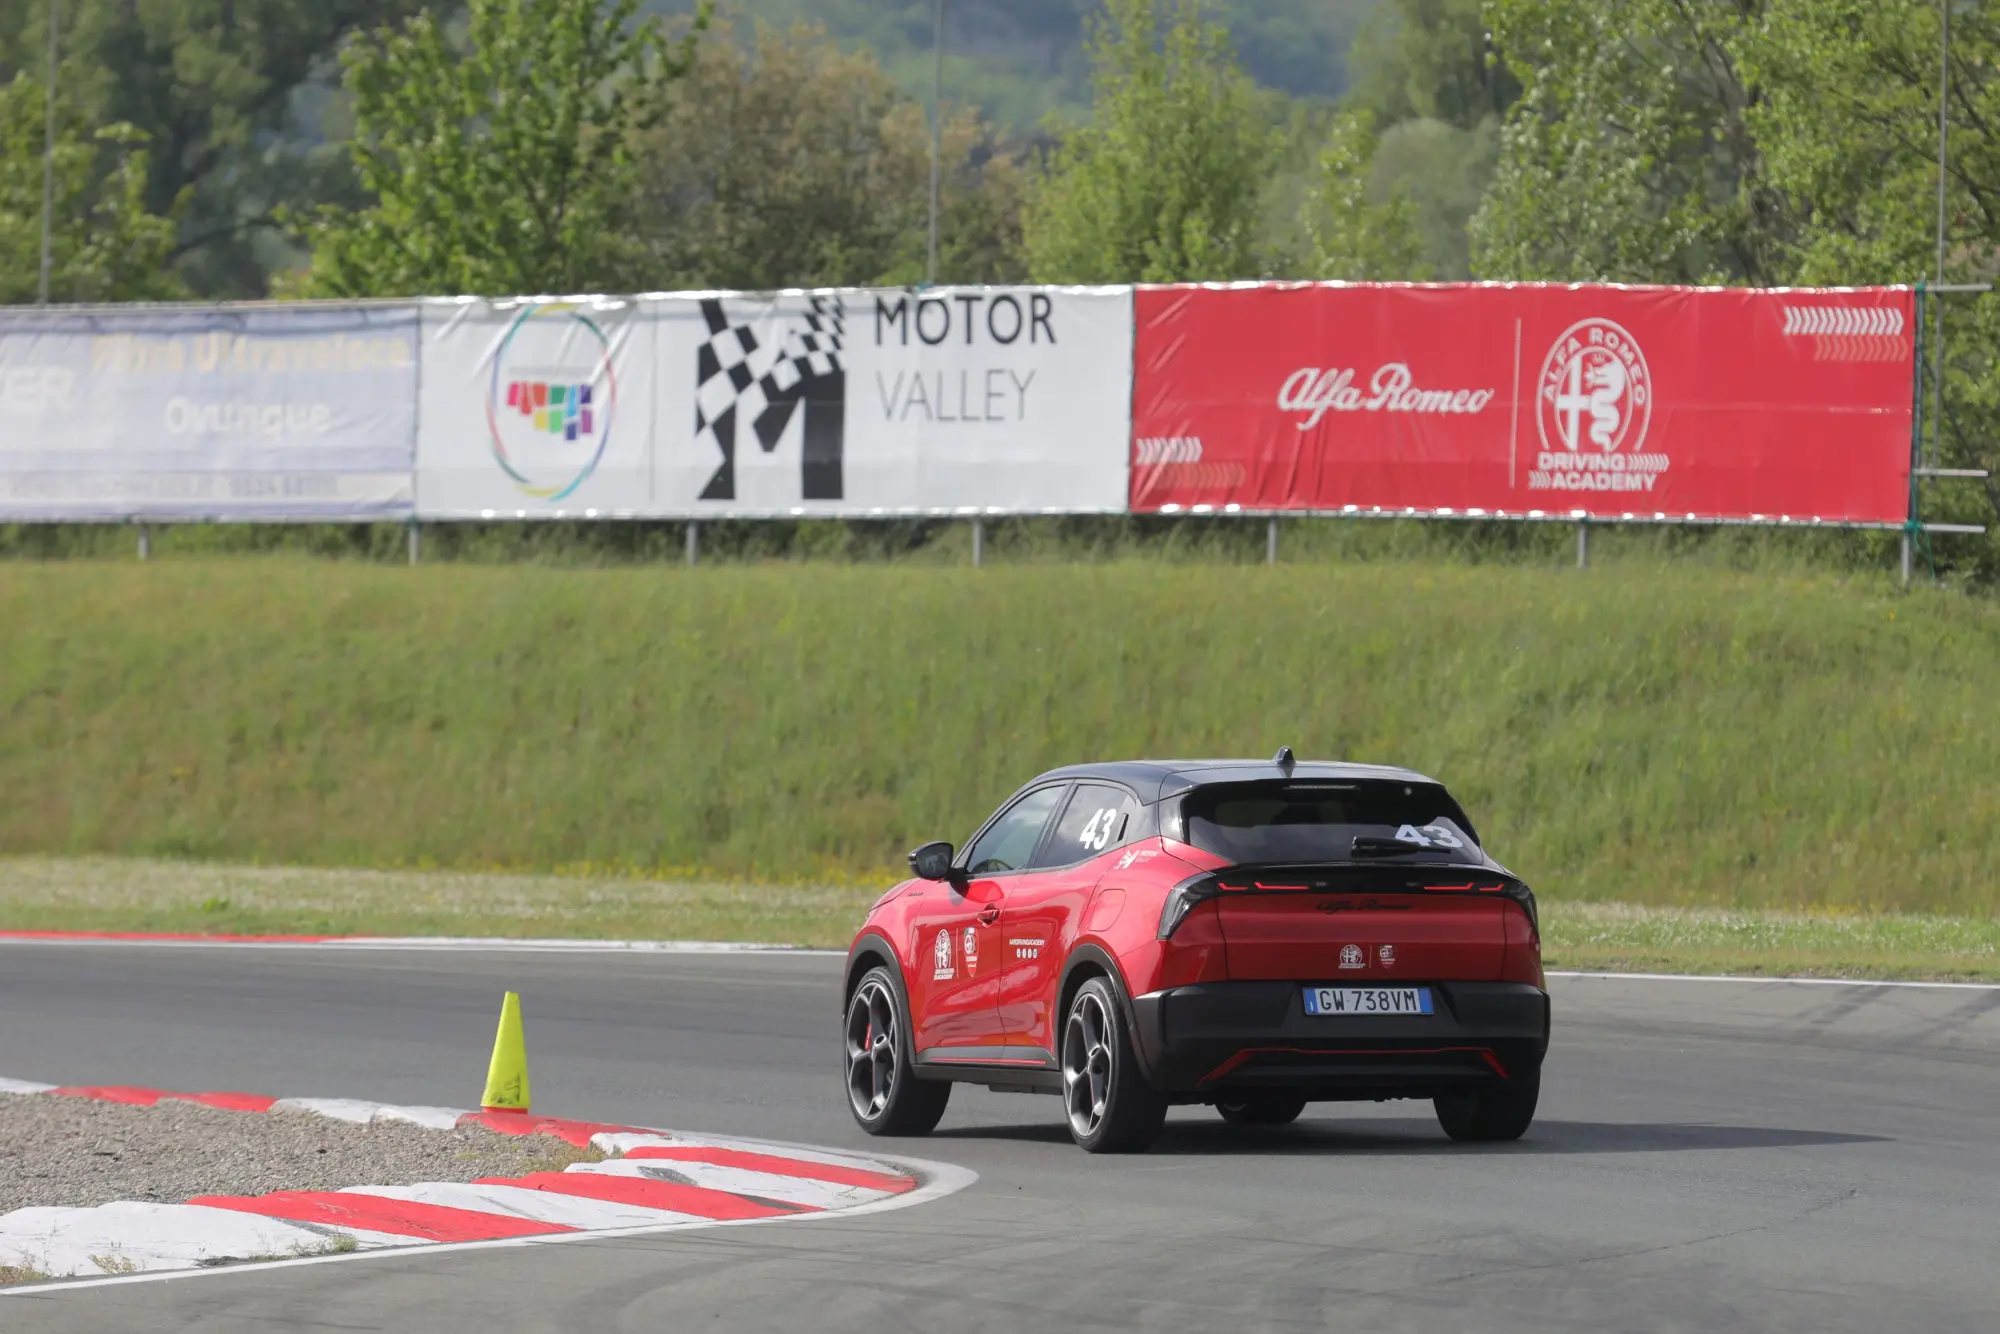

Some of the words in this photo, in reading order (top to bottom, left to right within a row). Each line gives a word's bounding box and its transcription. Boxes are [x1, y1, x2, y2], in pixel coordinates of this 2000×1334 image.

[875, 293, 1057, 346] MOTOR
[1544, 336, 1582, 401] ALFA
[1588, 327, 1646, 406] ROMEO
[875, 367, 1037, 421] VALLEY
[1277, 367, 1362, 431] Alfa
[1364, 361, 1495, 414] Romeo
[1537, 451, 1627, 471] DRIVING
[1552, 471, 1659, 492] ACADEMY
[1079, 808, 1117, 850] 43
[1394, 824, 1463, 848] 43
[1319, 990, 1345, 1011] GW
[1351, 990, 1417, 1011] 738VM
